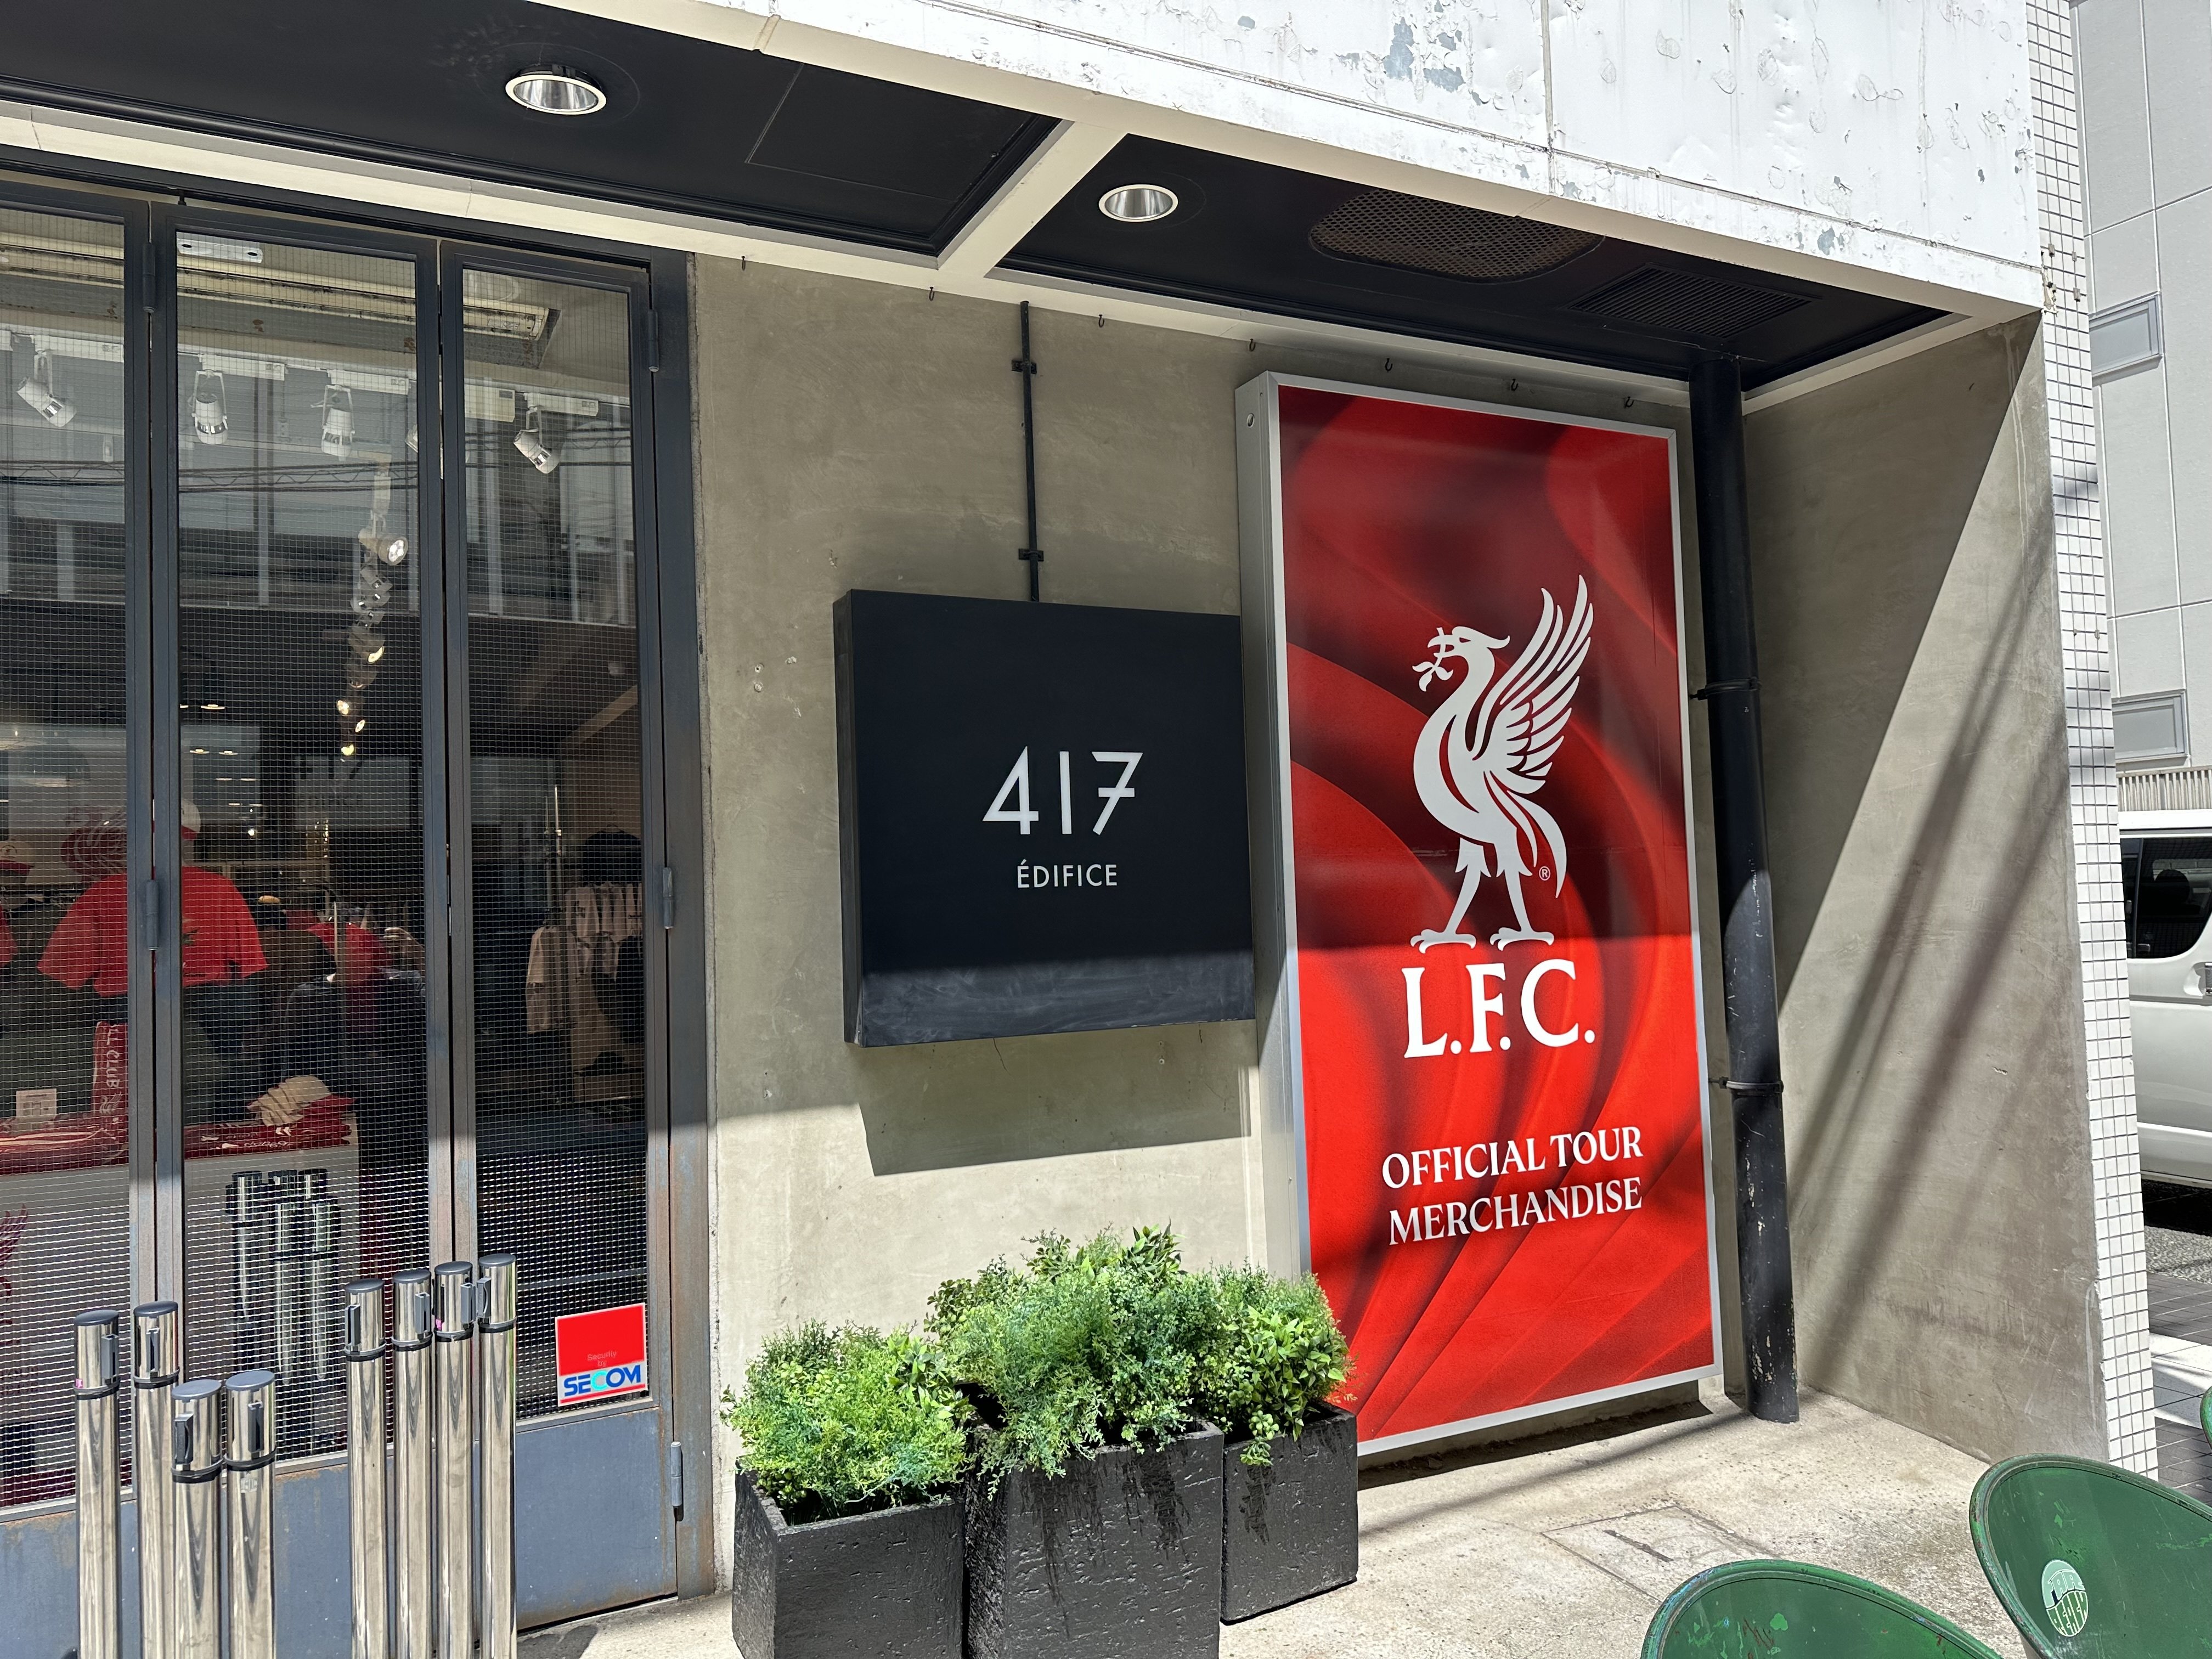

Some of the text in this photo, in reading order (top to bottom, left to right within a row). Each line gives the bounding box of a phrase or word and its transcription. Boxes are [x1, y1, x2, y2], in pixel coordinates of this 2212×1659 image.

[982, 746, 1143, 835] 417
[1017, 859, 1118, 888] ÉDIFICE
[1402, 959, 1596, 1058] L.F.C.
[106, 1049, 120, 1087] CLUB
[1382, 1126, 1644, 1188] OFFICIAL TOUR
[1389, 1177, 1643, 1246] MERCHANDISE
[587, 1350, 617, 1361] Security
[564, 1364, 641, 1397] SECOM
[2042, 1568, 2085, 1608] FAR
[2046, 1590, 2089, 1637] REACH
